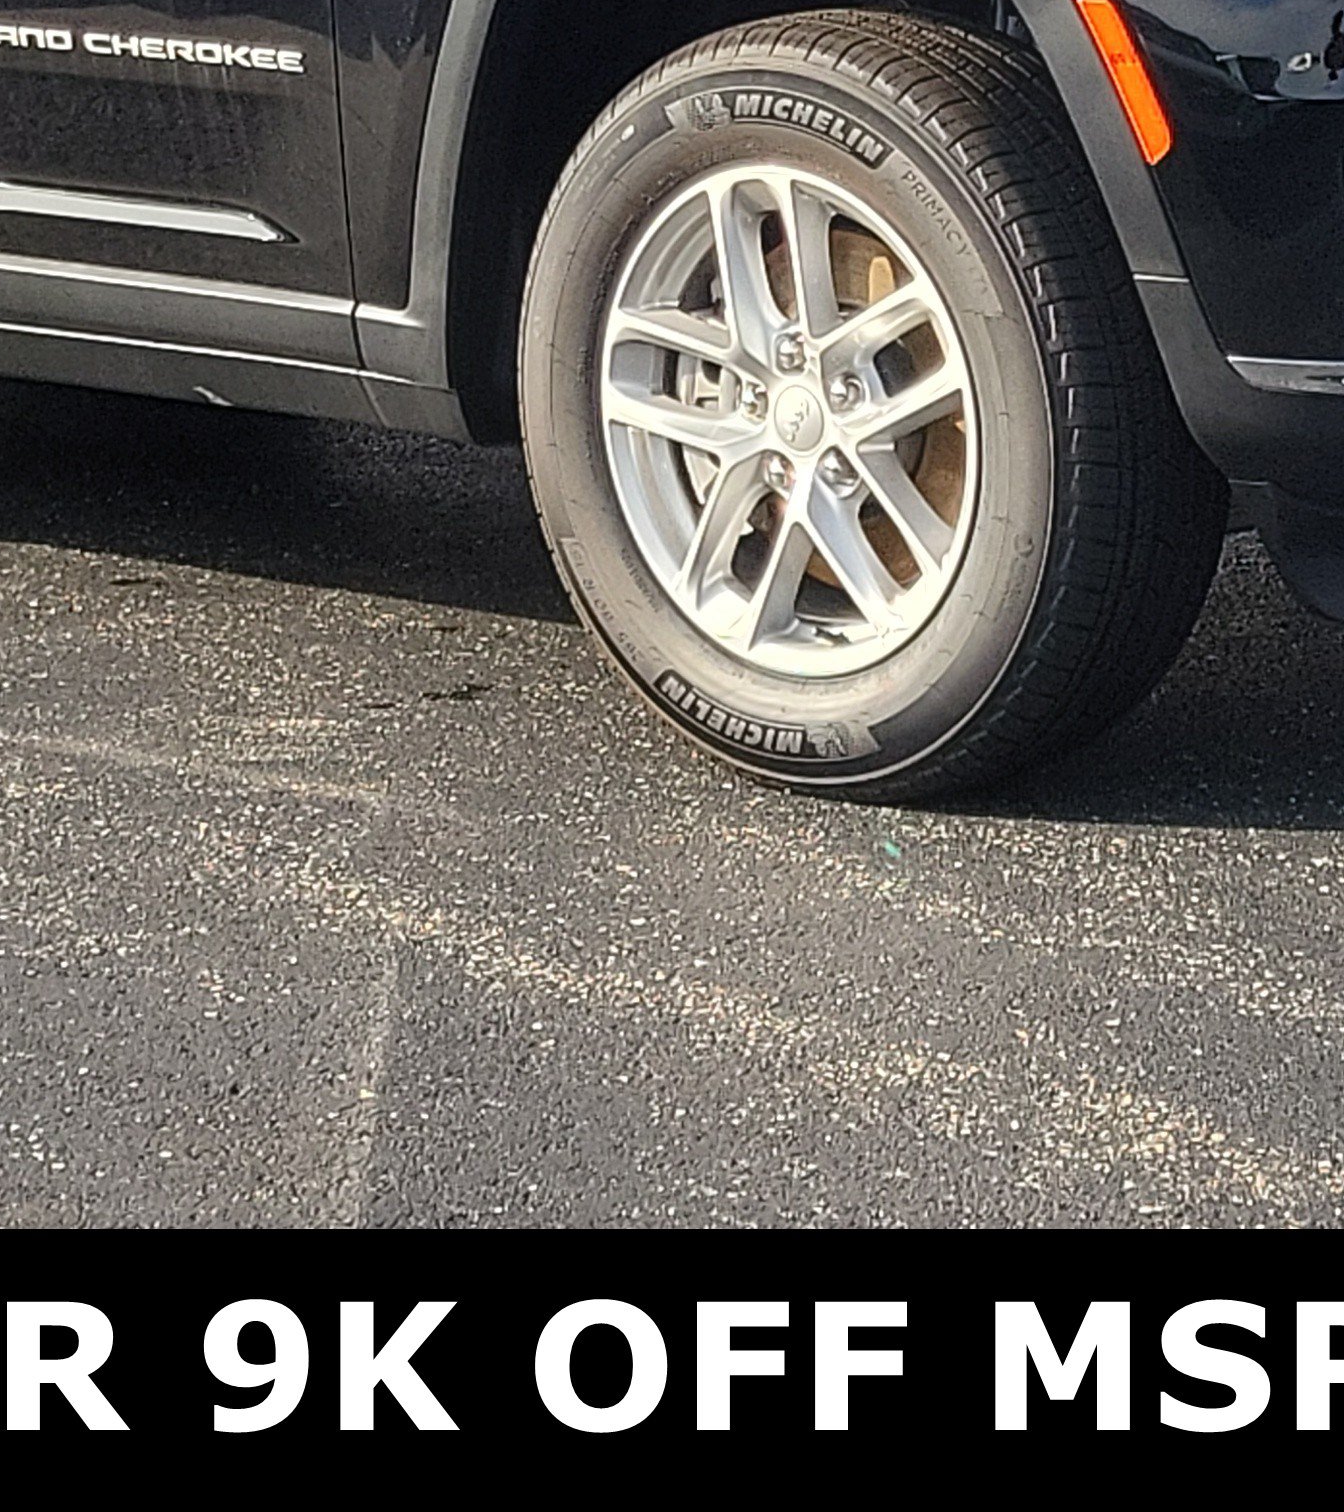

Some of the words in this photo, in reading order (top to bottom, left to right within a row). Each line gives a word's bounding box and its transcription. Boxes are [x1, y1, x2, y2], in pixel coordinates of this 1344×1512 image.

[82, 31, 307, 75] CHEROKEE
[733, 93, 885, 164] MICHELIN
[901, 169, 973, 259] PRIMACY
[660, 675, 804, 755] MICHELIN
